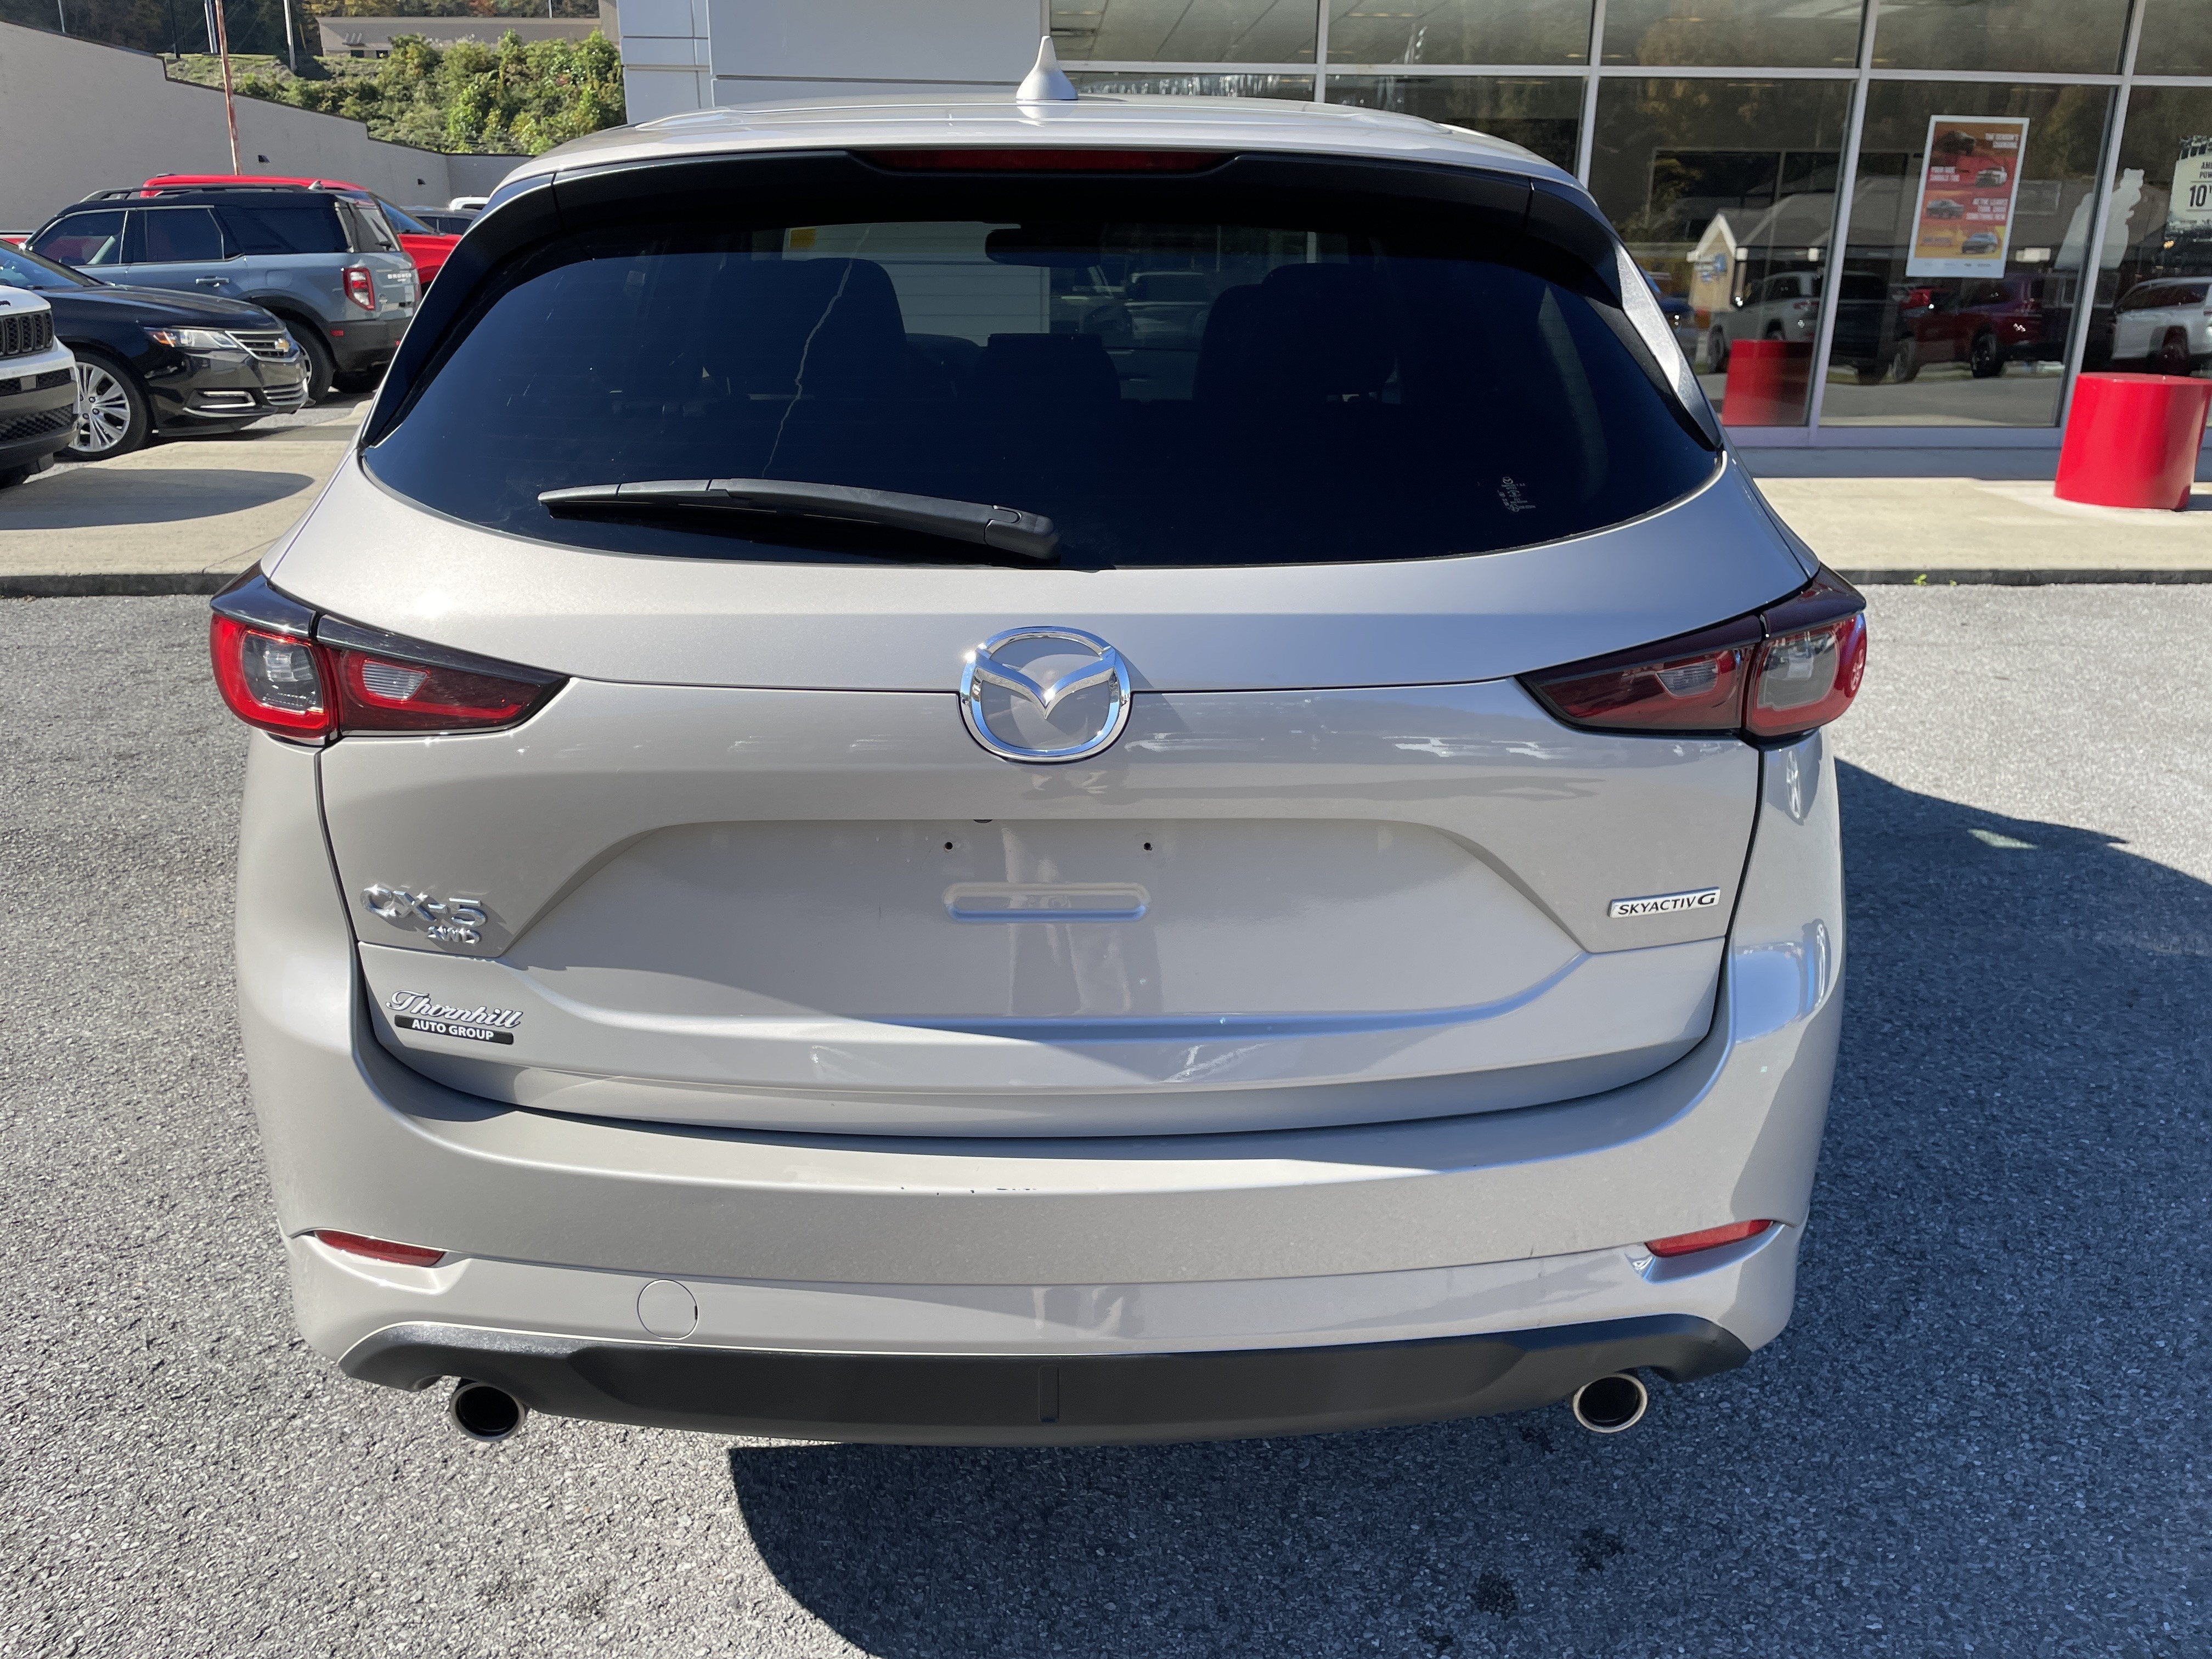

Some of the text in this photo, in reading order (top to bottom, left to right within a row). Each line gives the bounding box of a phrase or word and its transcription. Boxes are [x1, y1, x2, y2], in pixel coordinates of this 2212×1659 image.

[360, 884, 487, 927] CX-5
[386, 990, 524, 1029] Thornhill
[412, 1019, 494, 1041] AUTO GROUP
